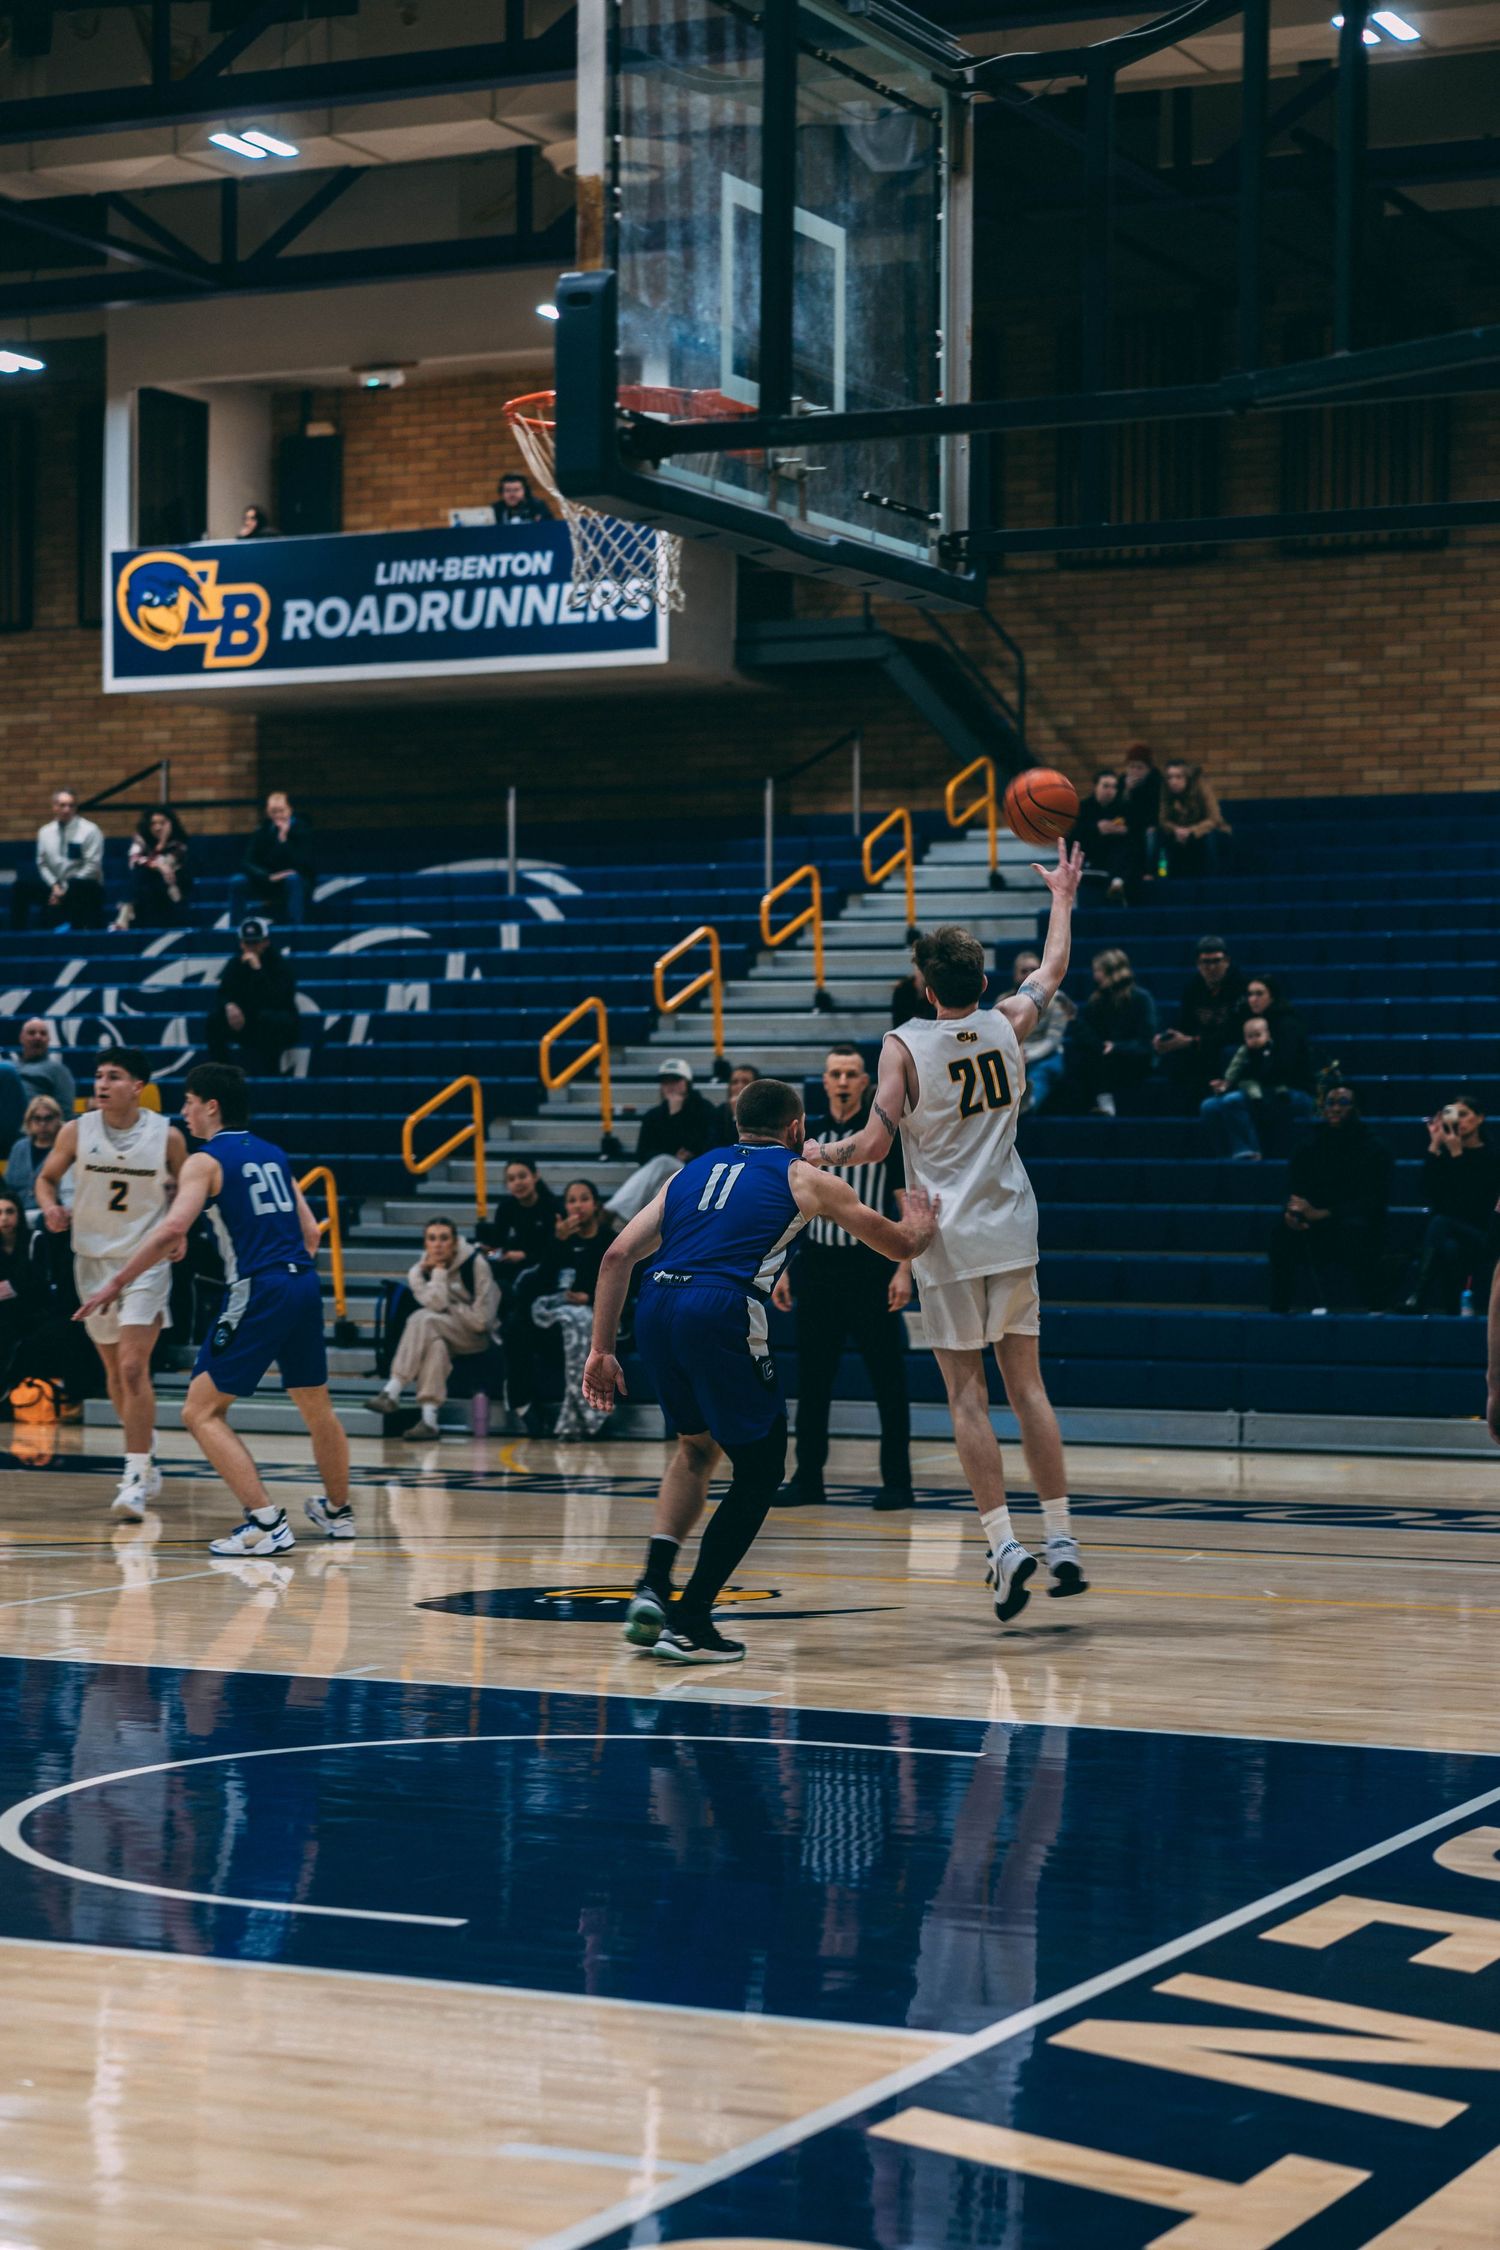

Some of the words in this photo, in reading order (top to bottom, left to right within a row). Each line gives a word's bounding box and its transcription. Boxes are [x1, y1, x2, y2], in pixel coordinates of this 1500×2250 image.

[374, 550, 553, 586] LINN-BENTON
[281, 576, 653, 641] ROADRUNNERS
[947, 1048, 1012, 1121] 20
[108, 1180, 129, 1214] 2
[242, 1162, 294, 1216] 20
[697, 1162, 746, 1211] 11
